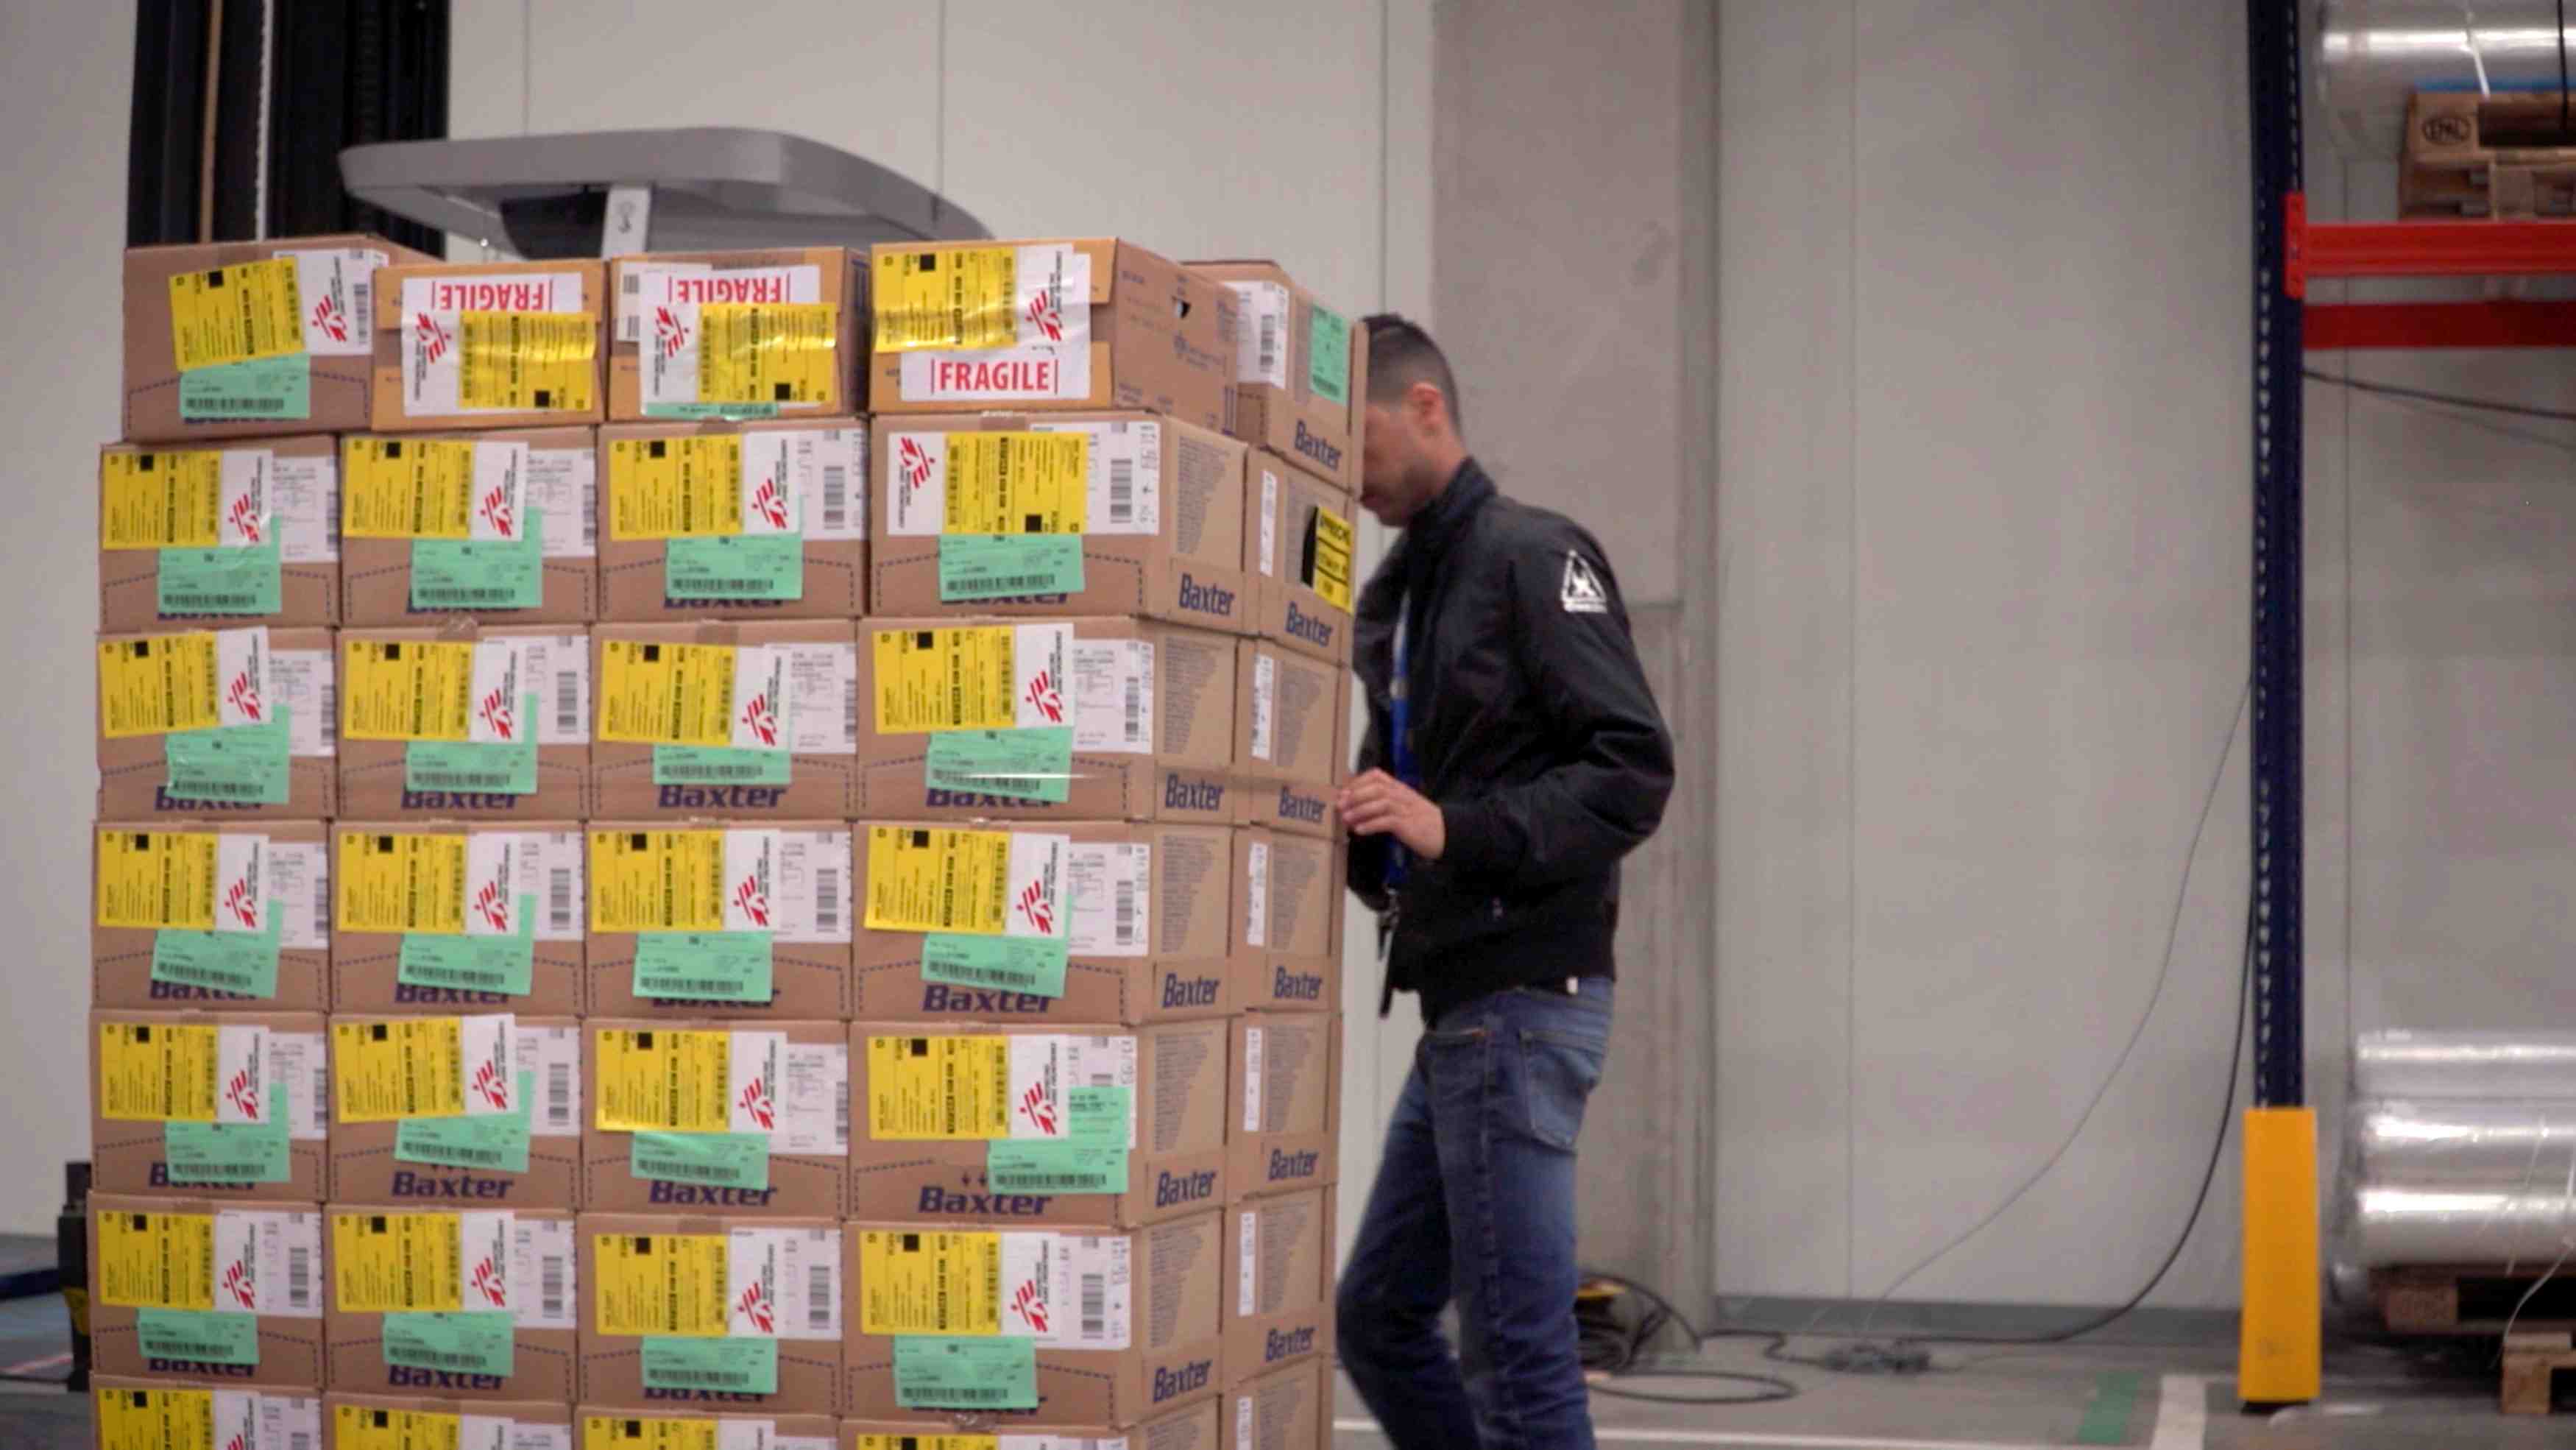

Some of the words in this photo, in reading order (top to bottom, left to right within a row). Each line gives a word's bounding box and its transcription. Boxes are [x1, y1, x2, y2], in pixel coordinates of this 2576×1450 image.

[439, 283, 544, 311] FRAGILE
[678, 276, 782, 303] FRAGILE
[939, 362, 1049, 390] FRAGILE
[1295, 420, 1342, 471] Baxter
[1179, 573, 1234, 615] Baxter
[1285, 601, 1333, 647] Baxter
[659, 785, 786, 807] Baxter
[1166, 773, 1224, 811] Baxter
[1279, 785, 1326, 824] Baxter
[1163, 972, 1220, 1007] Baxter
[1274, 966, 1322, 1000] Baxter
[1268, 1148, 1319, 1180] Baxter
[392, 1172, 514, 1198] Baxter
[650, 1180, 777, 1206] Baxter
[919, 1186, 1052, 1214] Baxter
[1156, 1170, 1216, 1207] Baxter
[1265, 1327, 1315, 1361] Baxter
[1153, 1359, 1213, 1403] Baxter
